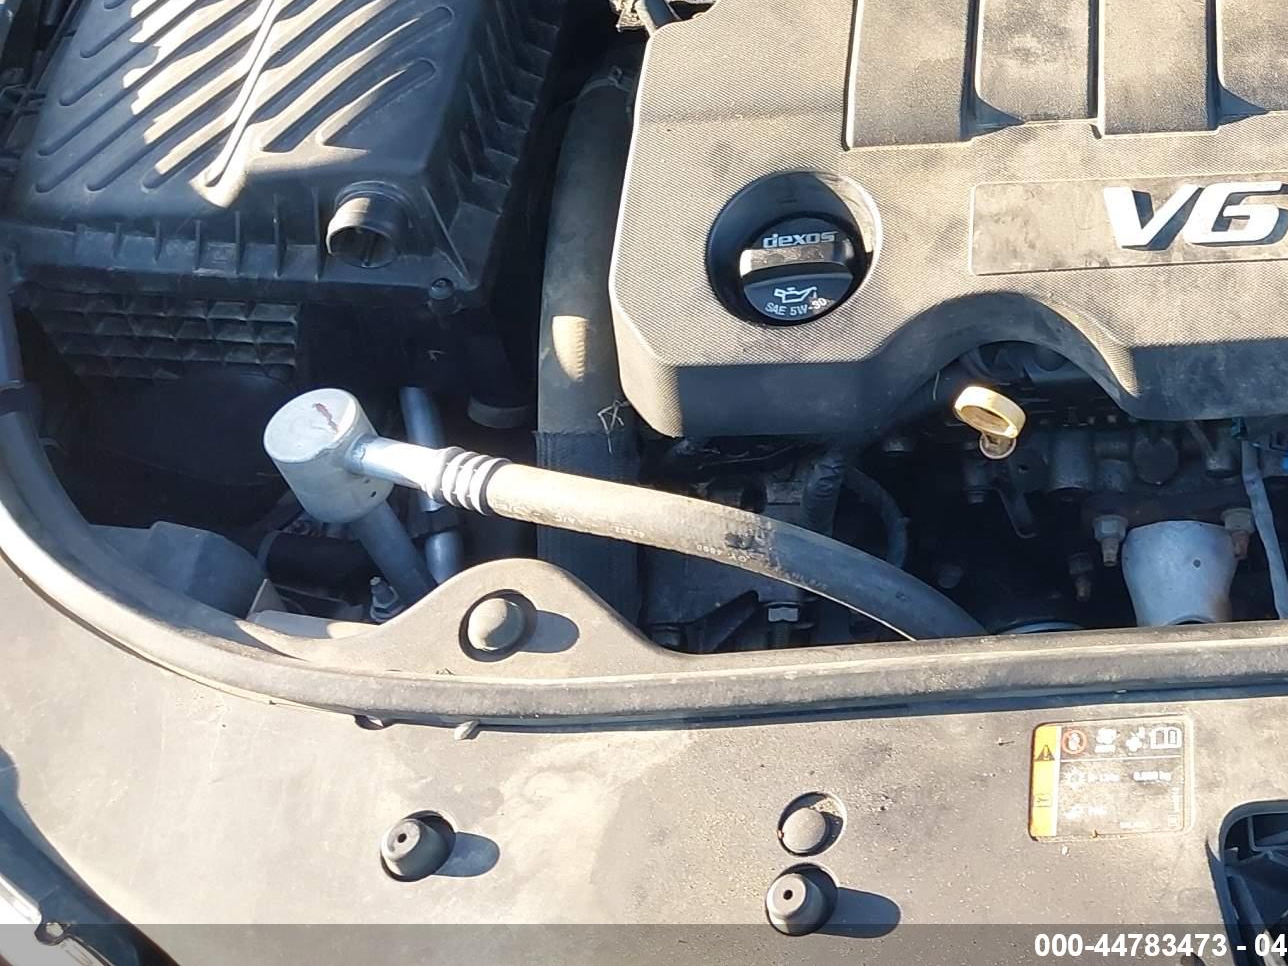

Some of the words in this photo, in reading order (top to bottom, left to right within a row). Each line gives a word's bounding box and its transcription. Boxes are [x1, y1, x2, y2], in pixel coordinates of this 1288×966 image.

[1103, 180, 1287, 249] V6
[763, 231, 838, 249] dexos
[764, 301, 787, 316] SAE
